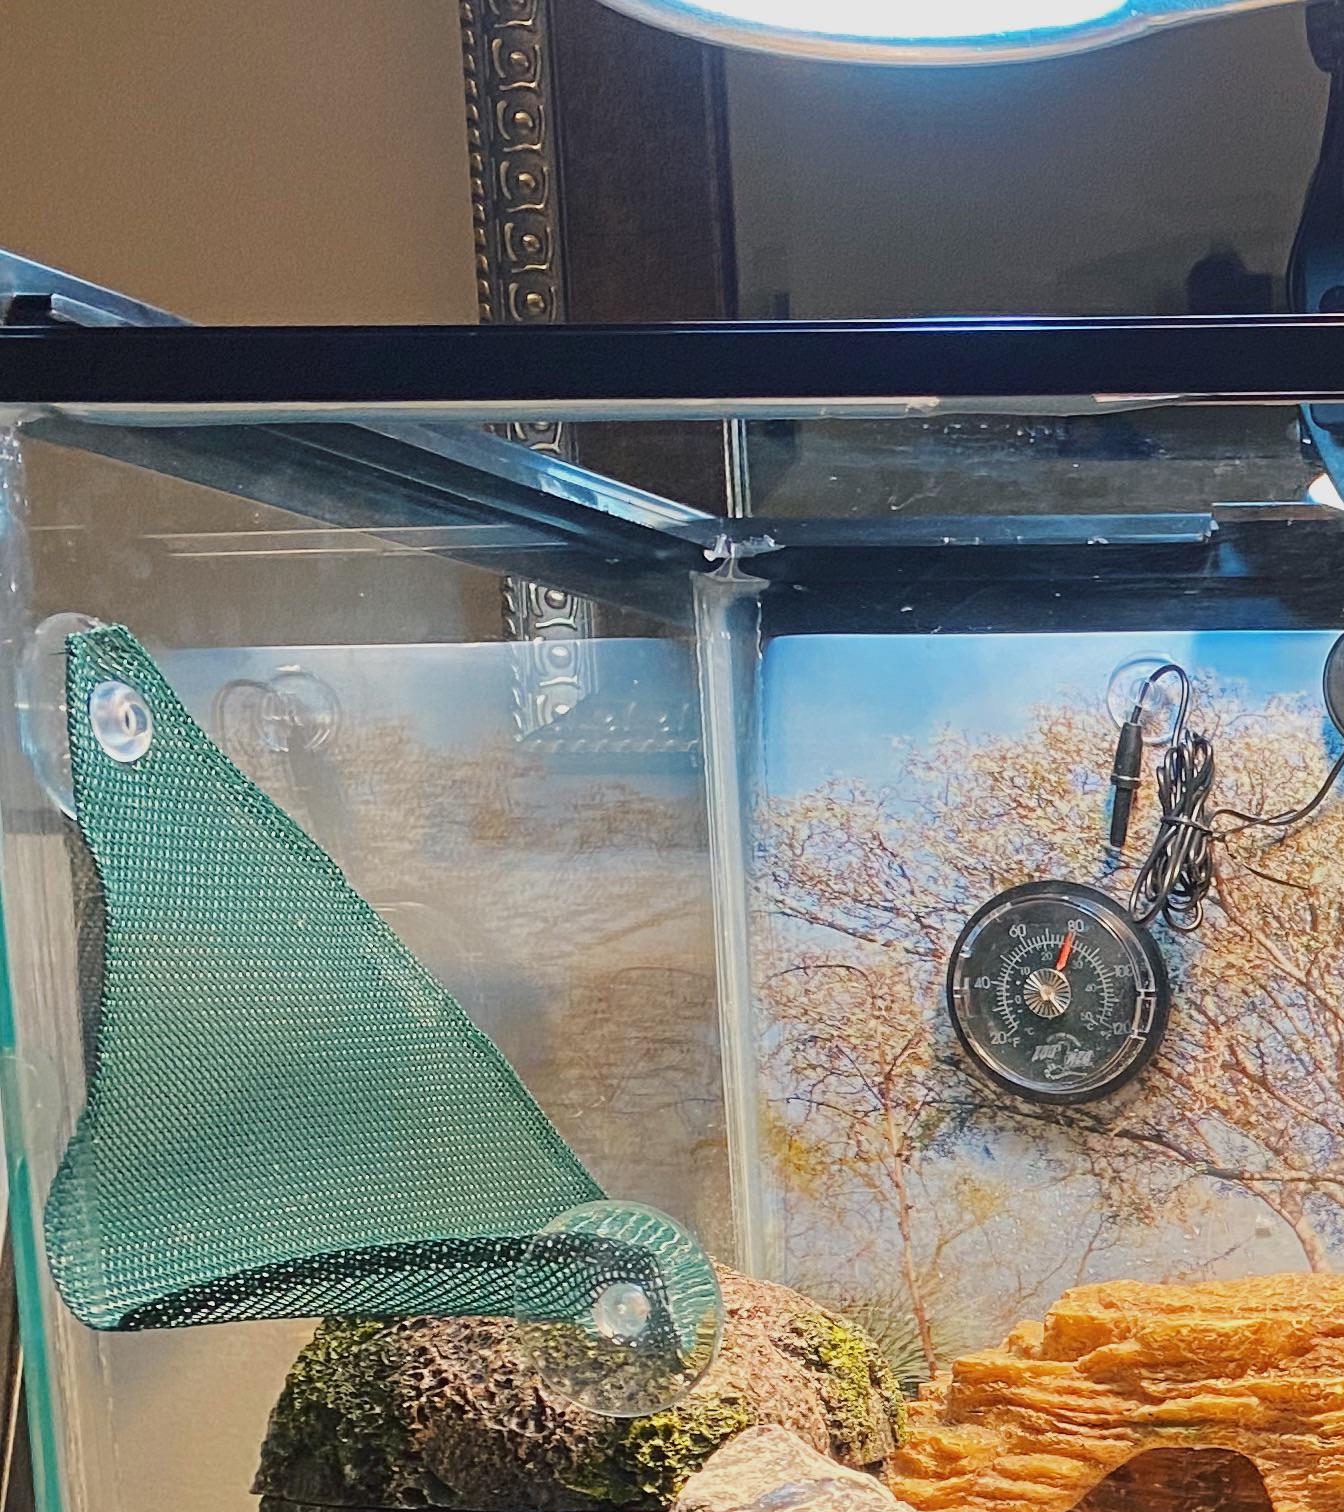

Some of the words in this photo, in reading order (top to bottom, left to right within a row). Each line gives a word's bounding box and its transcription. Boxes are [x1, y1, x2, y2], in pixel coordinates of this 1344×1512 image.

[1009, 924, 1027, 938] 60
[1067, 919, 1085, 933] 80
[1041, 951, 1053, 961] 20
[1020, 967, 1031, 975] 10
[974, 976, 991, 989] 40
[990, 1033, 1007, 1045] 20
